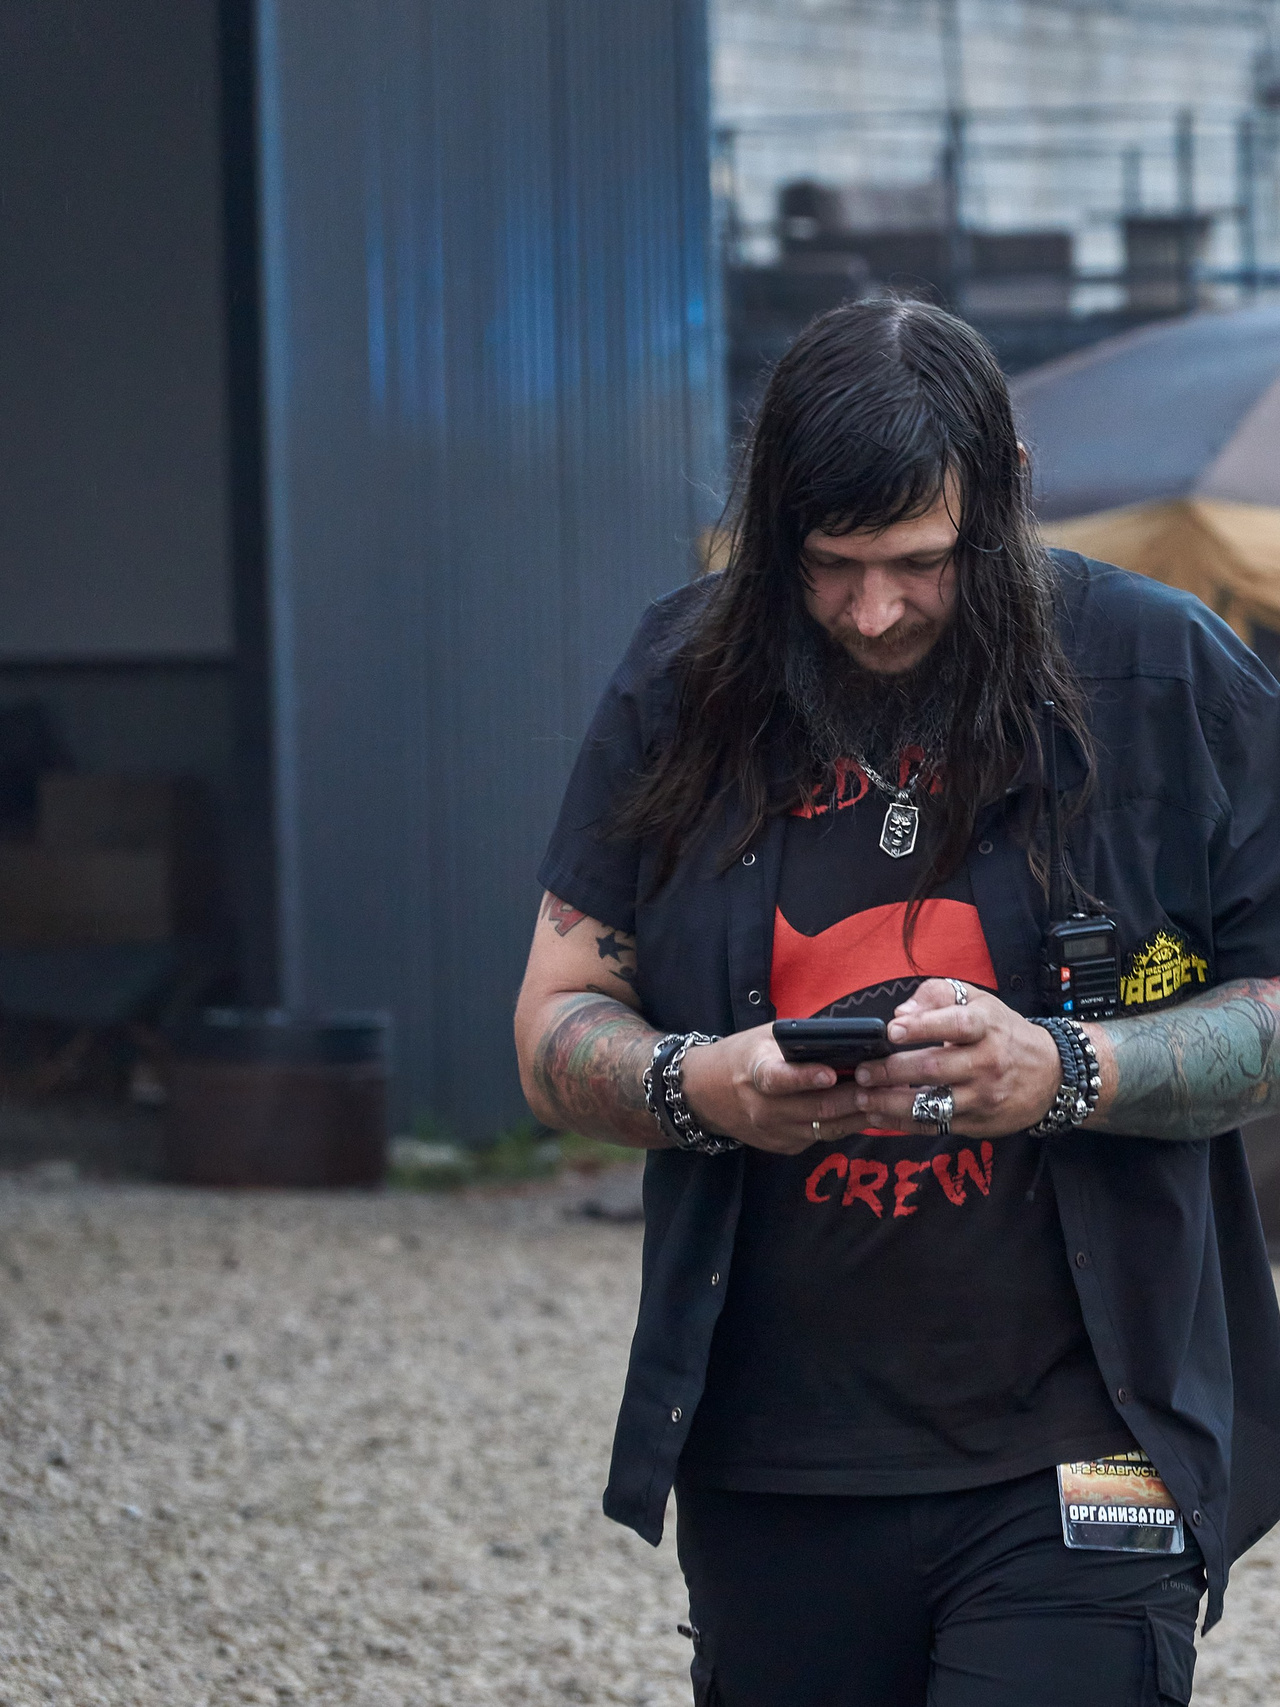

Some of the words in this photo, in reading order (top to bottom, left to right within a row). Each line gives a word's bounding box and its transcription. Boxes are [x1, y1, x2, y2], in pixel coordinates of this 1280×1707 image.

[805, 1141, 994, 1218] CREW
[1107, 1464, 1160, 1477] АВГУСТ
[1069, 1504, 1175, 1525] ОРГАНИЗАТОР
